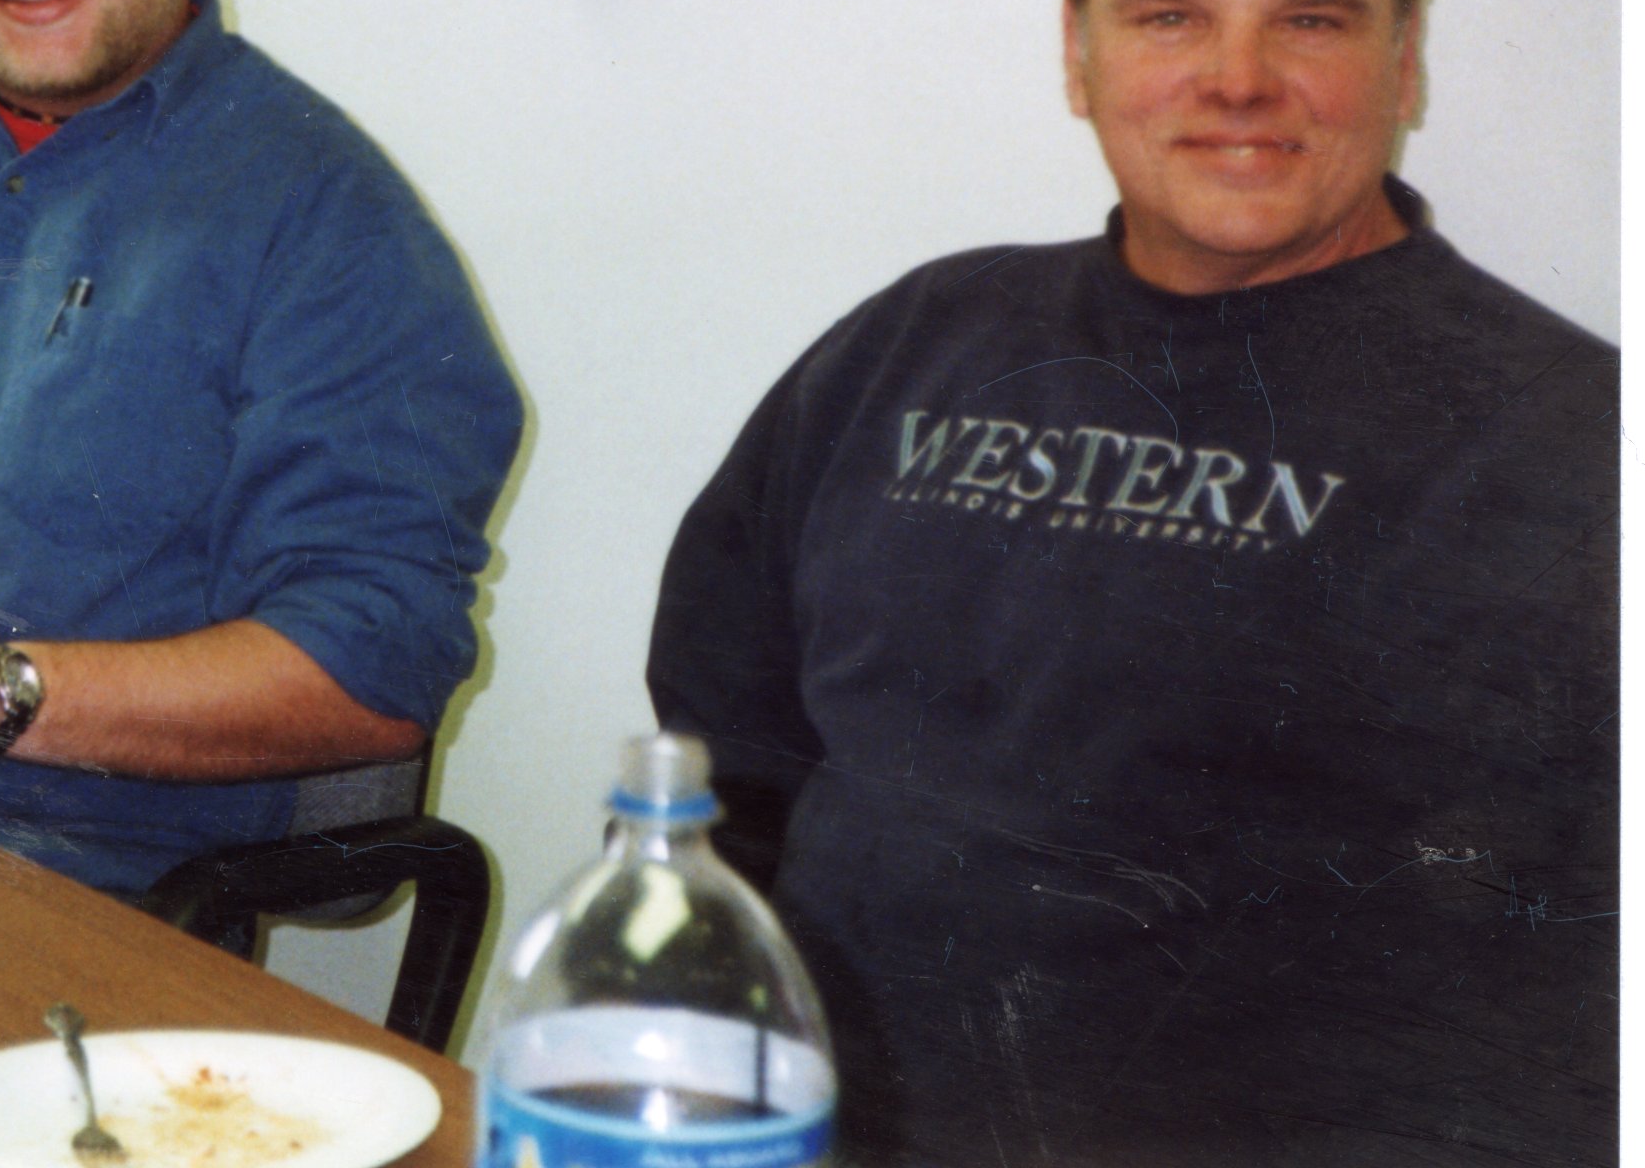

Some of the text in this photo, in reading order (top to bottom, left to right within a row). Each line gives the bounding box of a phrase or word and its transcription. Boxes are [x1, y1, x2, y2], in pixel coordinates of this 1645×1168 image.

[882, 484, 1277, 553] ILLINOIS UNIVERSITY
[896, 409, 1346, 537] WESTERN
